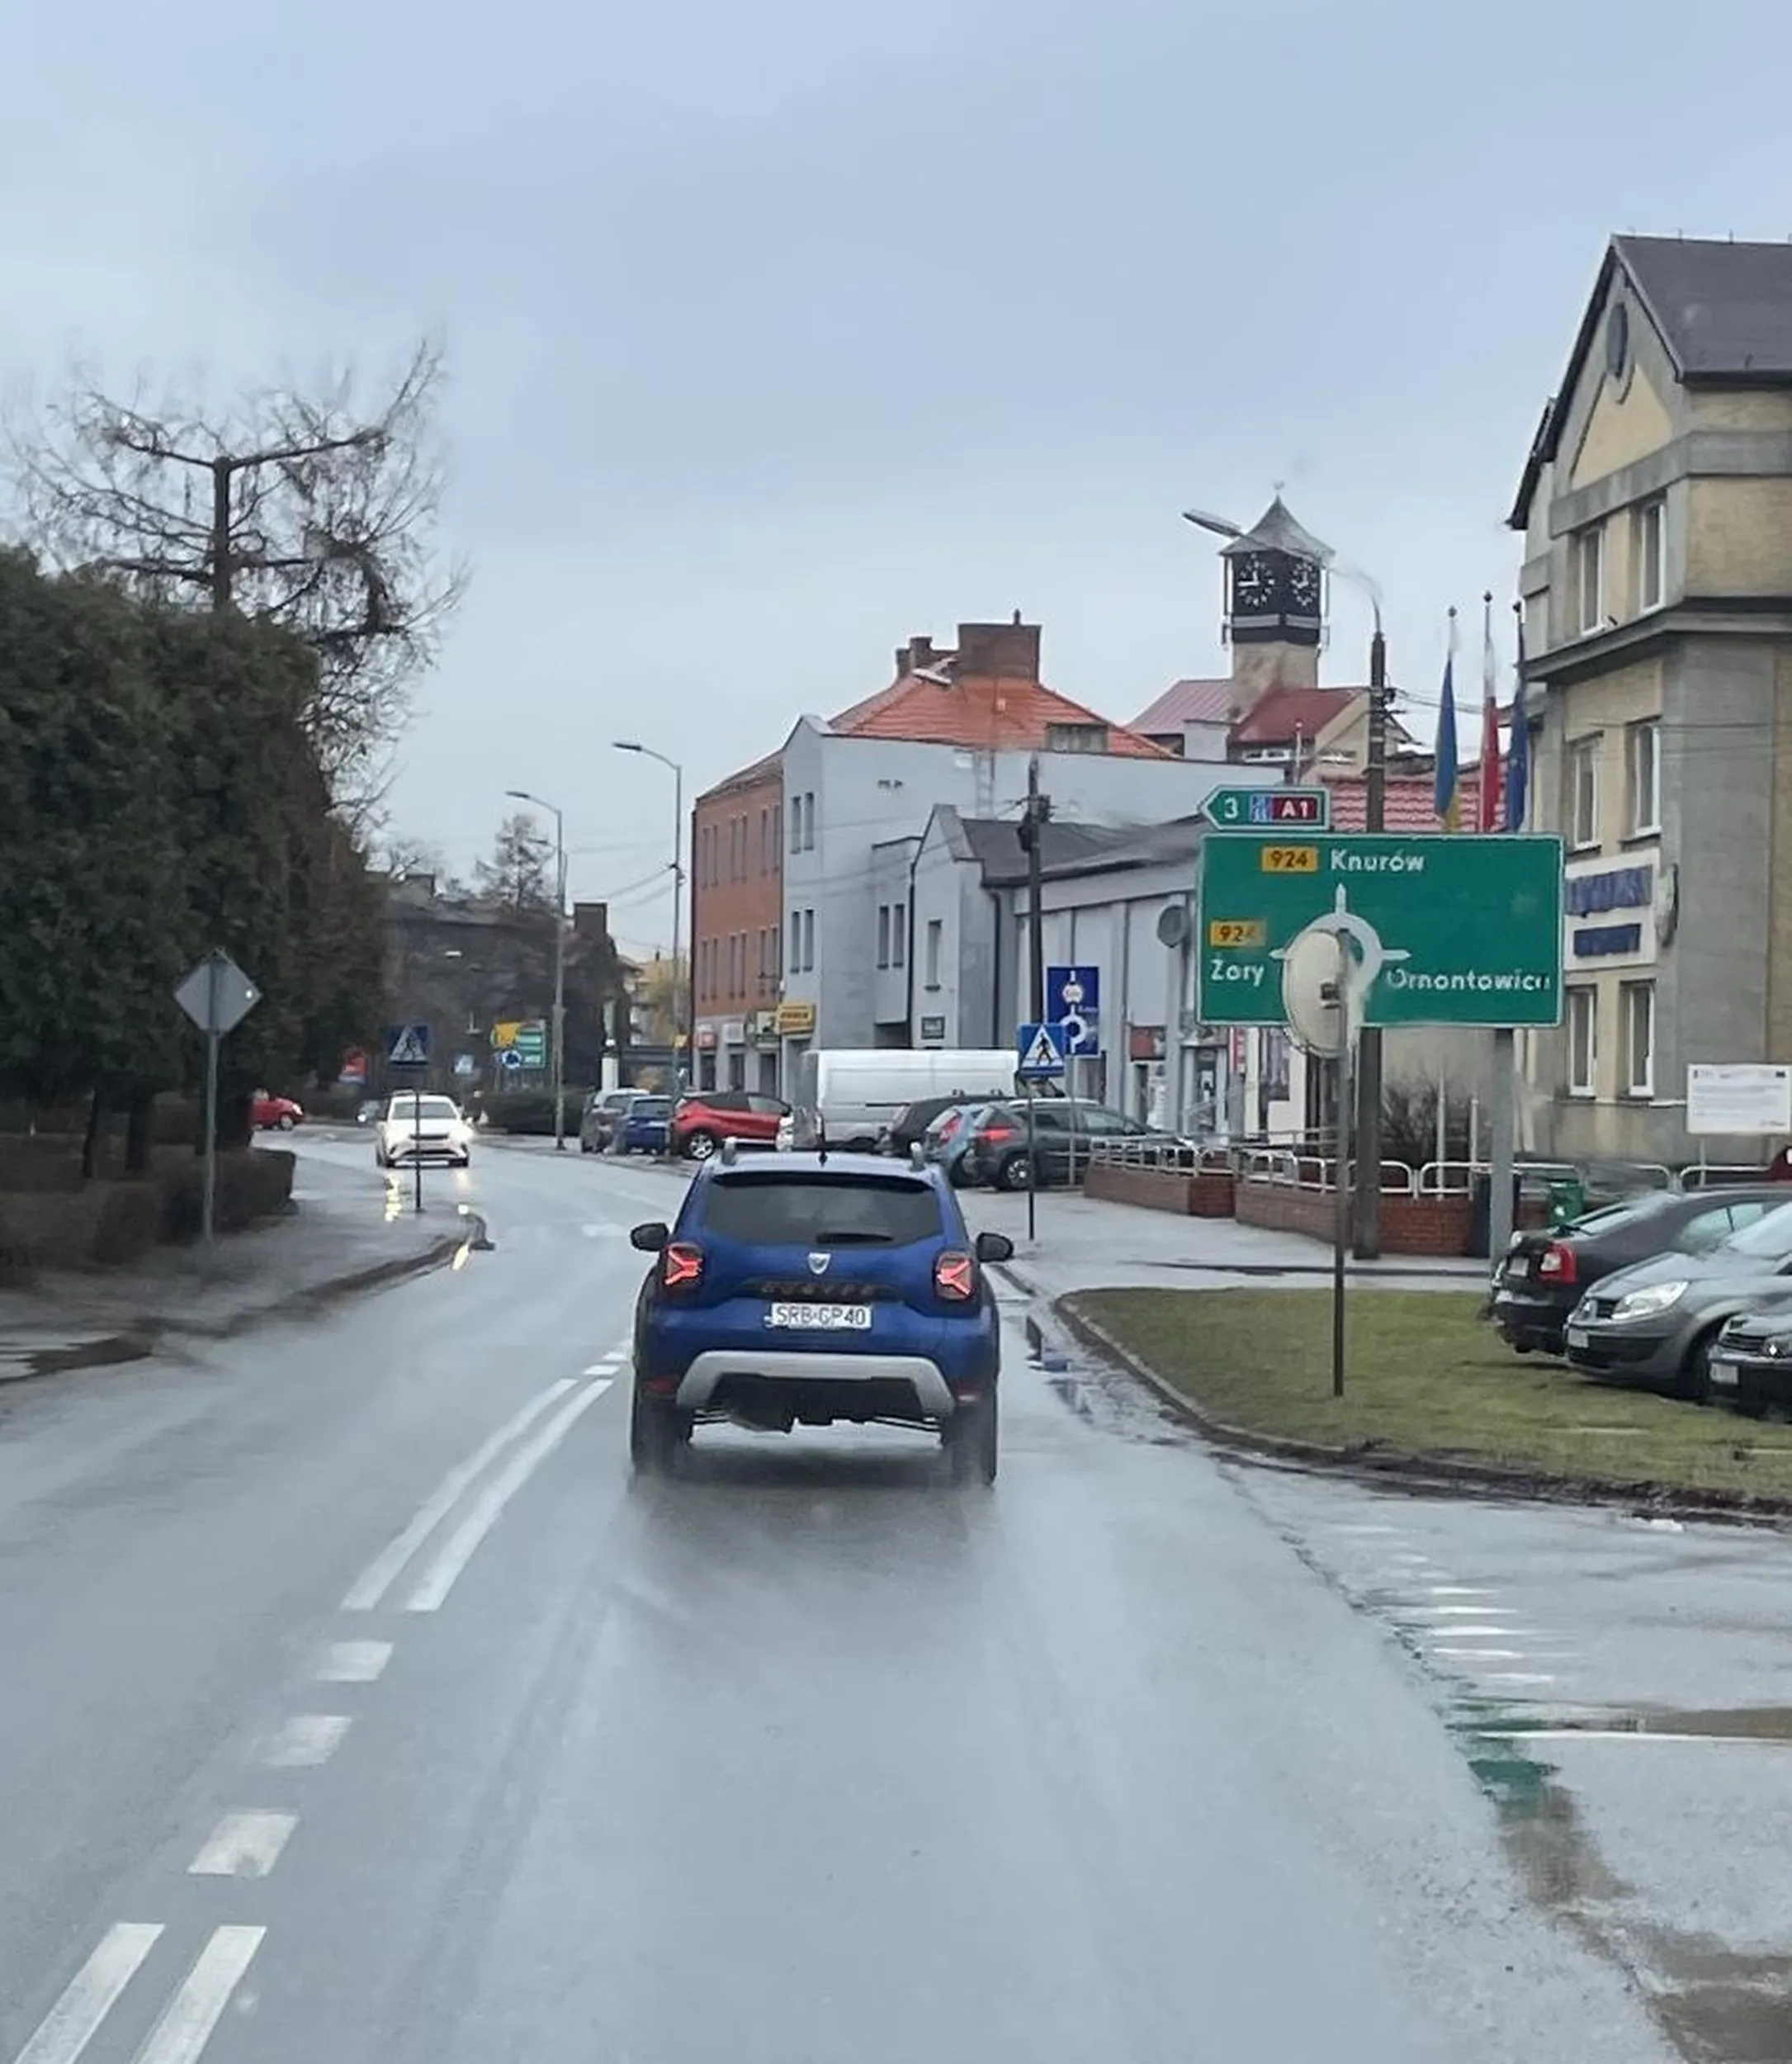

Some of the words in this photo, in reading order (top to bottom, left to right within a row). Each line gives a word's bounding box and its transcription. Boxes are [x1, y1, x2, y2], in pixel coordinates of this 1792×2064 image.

[1223, 797, 1238, 819] 3
[1281, 800, 1309, 818] A1
[1270, 850, 1308, 869] 924
[1331, 848, 1425, 871] Knurów
[1211, 952, 1265, 987] Żory
